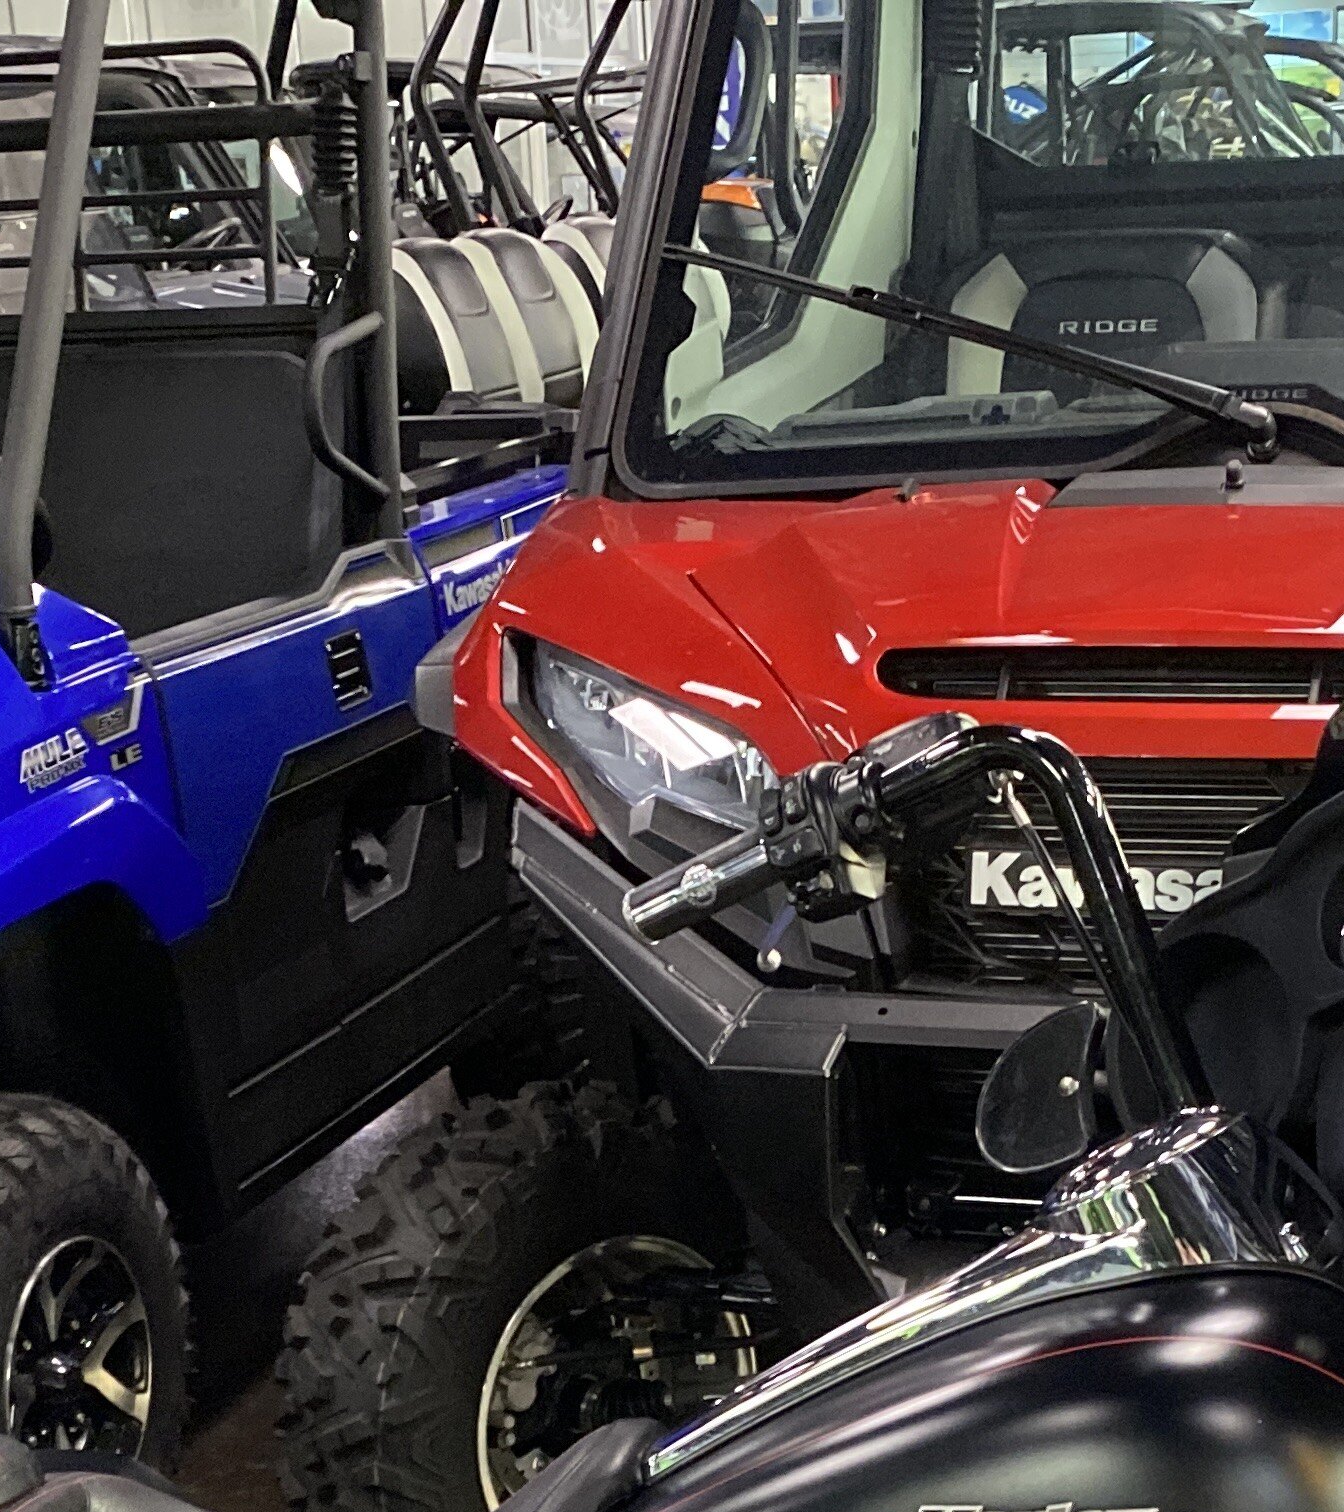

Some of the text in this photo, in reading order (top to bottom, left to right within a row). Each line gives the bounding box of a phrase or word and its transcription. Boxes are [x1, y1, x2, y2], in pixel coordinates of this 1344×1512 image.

[1058, 318, 1159, 335] RIDGE
[1233, 387, 1309, 400] IDGE
[20, 728, 90, 784] MULE
[110, 743, 143, 771] LE
